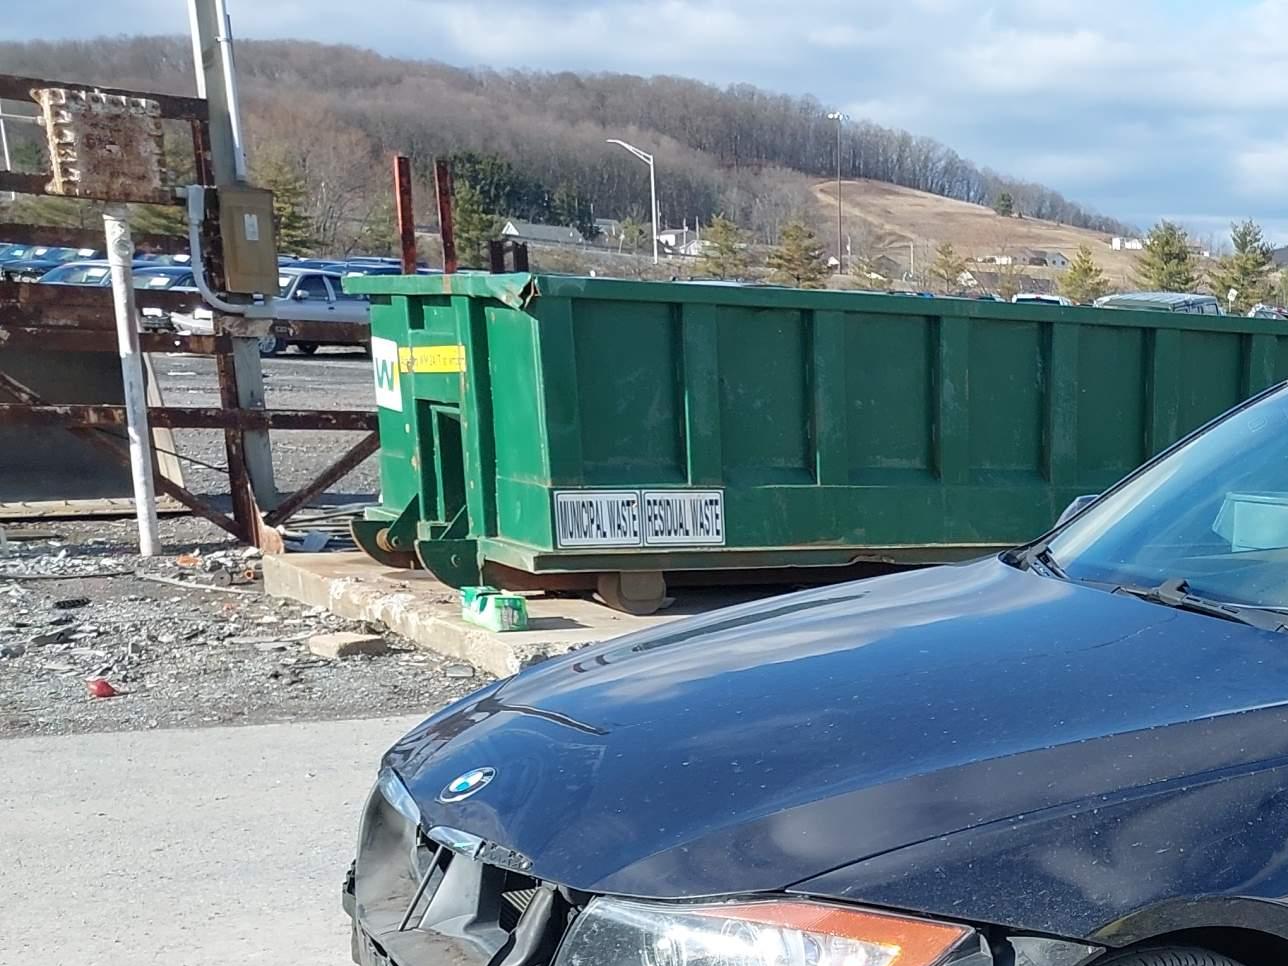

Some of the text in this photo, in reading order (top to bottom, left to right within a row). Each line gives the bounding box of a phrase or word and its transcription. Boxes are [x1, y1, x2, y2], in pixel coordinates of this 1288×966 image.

[559, 499, 638, 539] MUNICIPAL WASTE
[647, 499, 720, 537] RESIDUAL WASTE
